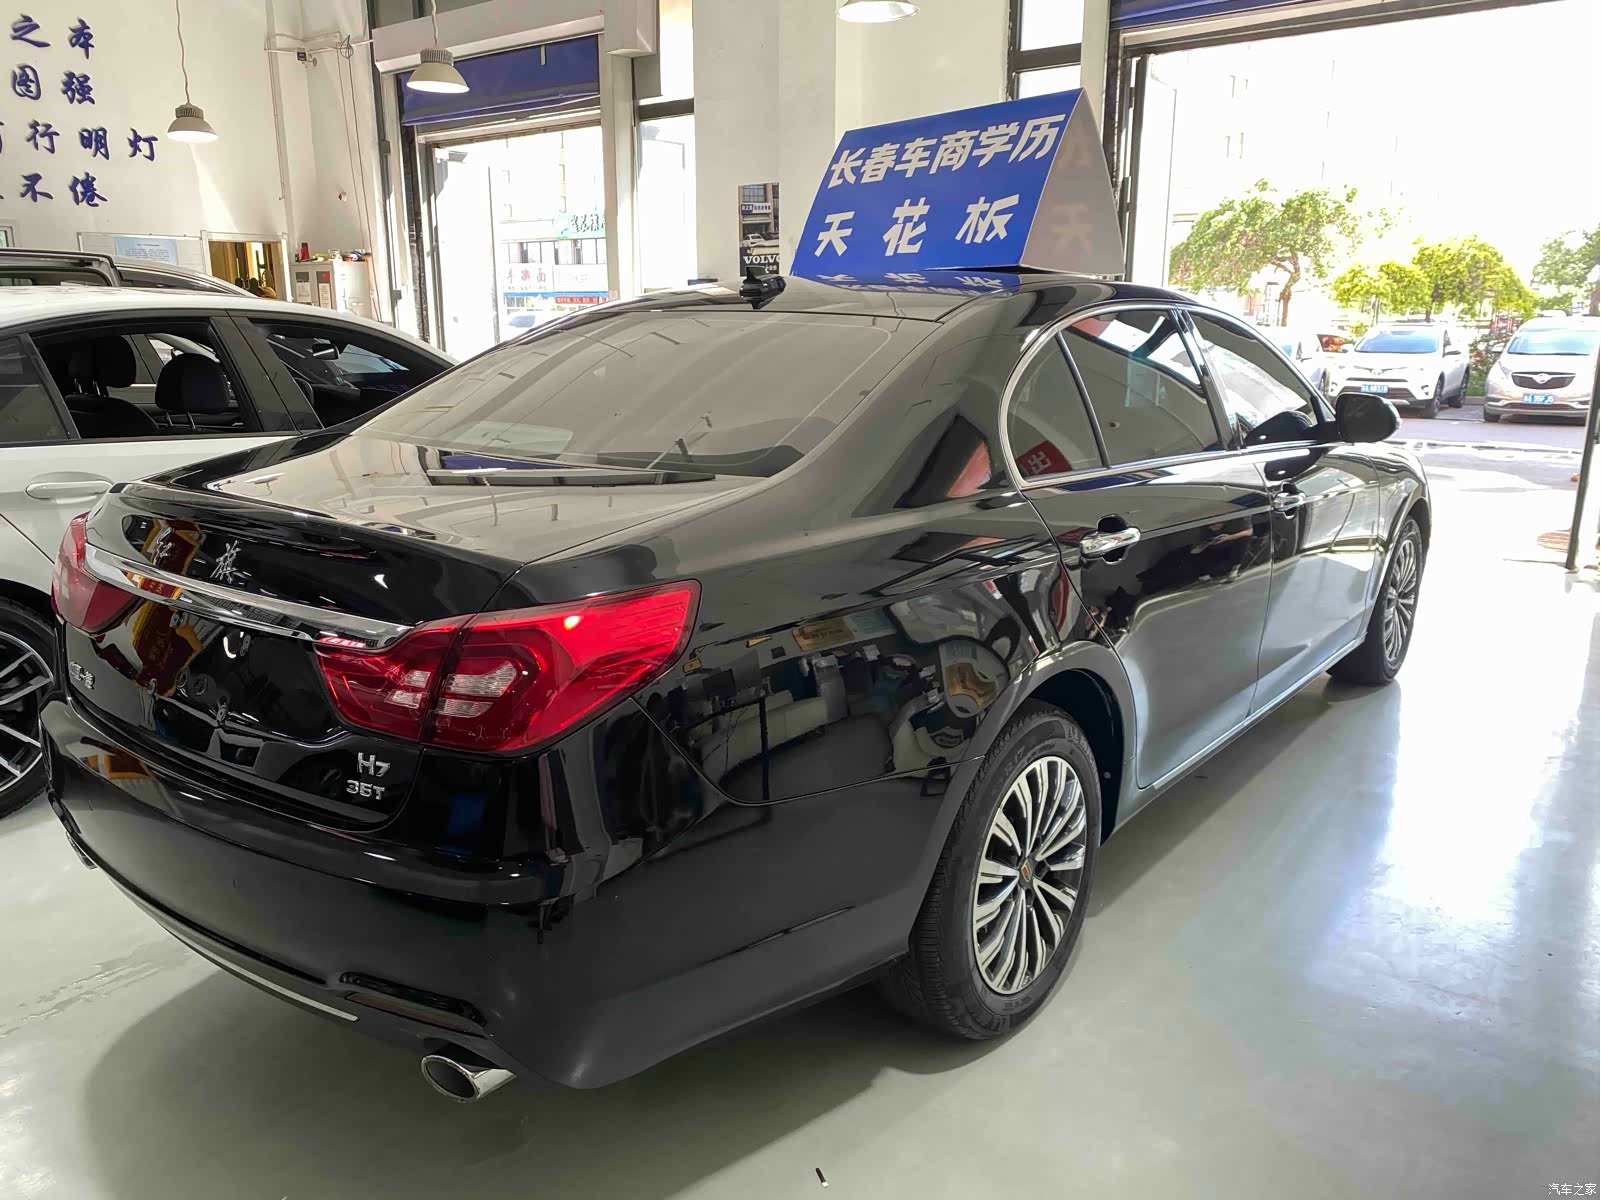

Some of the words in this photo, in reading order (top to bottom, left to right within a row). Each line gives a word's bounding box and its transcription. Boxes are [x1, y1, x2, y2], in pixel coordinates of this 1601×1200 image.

[11, 14, 95, 59] 之本
[11, 64, 96, 105] 图强
[0, 120, 158, 161] 行明灯
[828, 113, 1066, 190] 长春车商学历
[814, 193, 1020, 257] 天花板
[357, 752, 391, 777] H7
[346, 779, 386, 801] 35T
